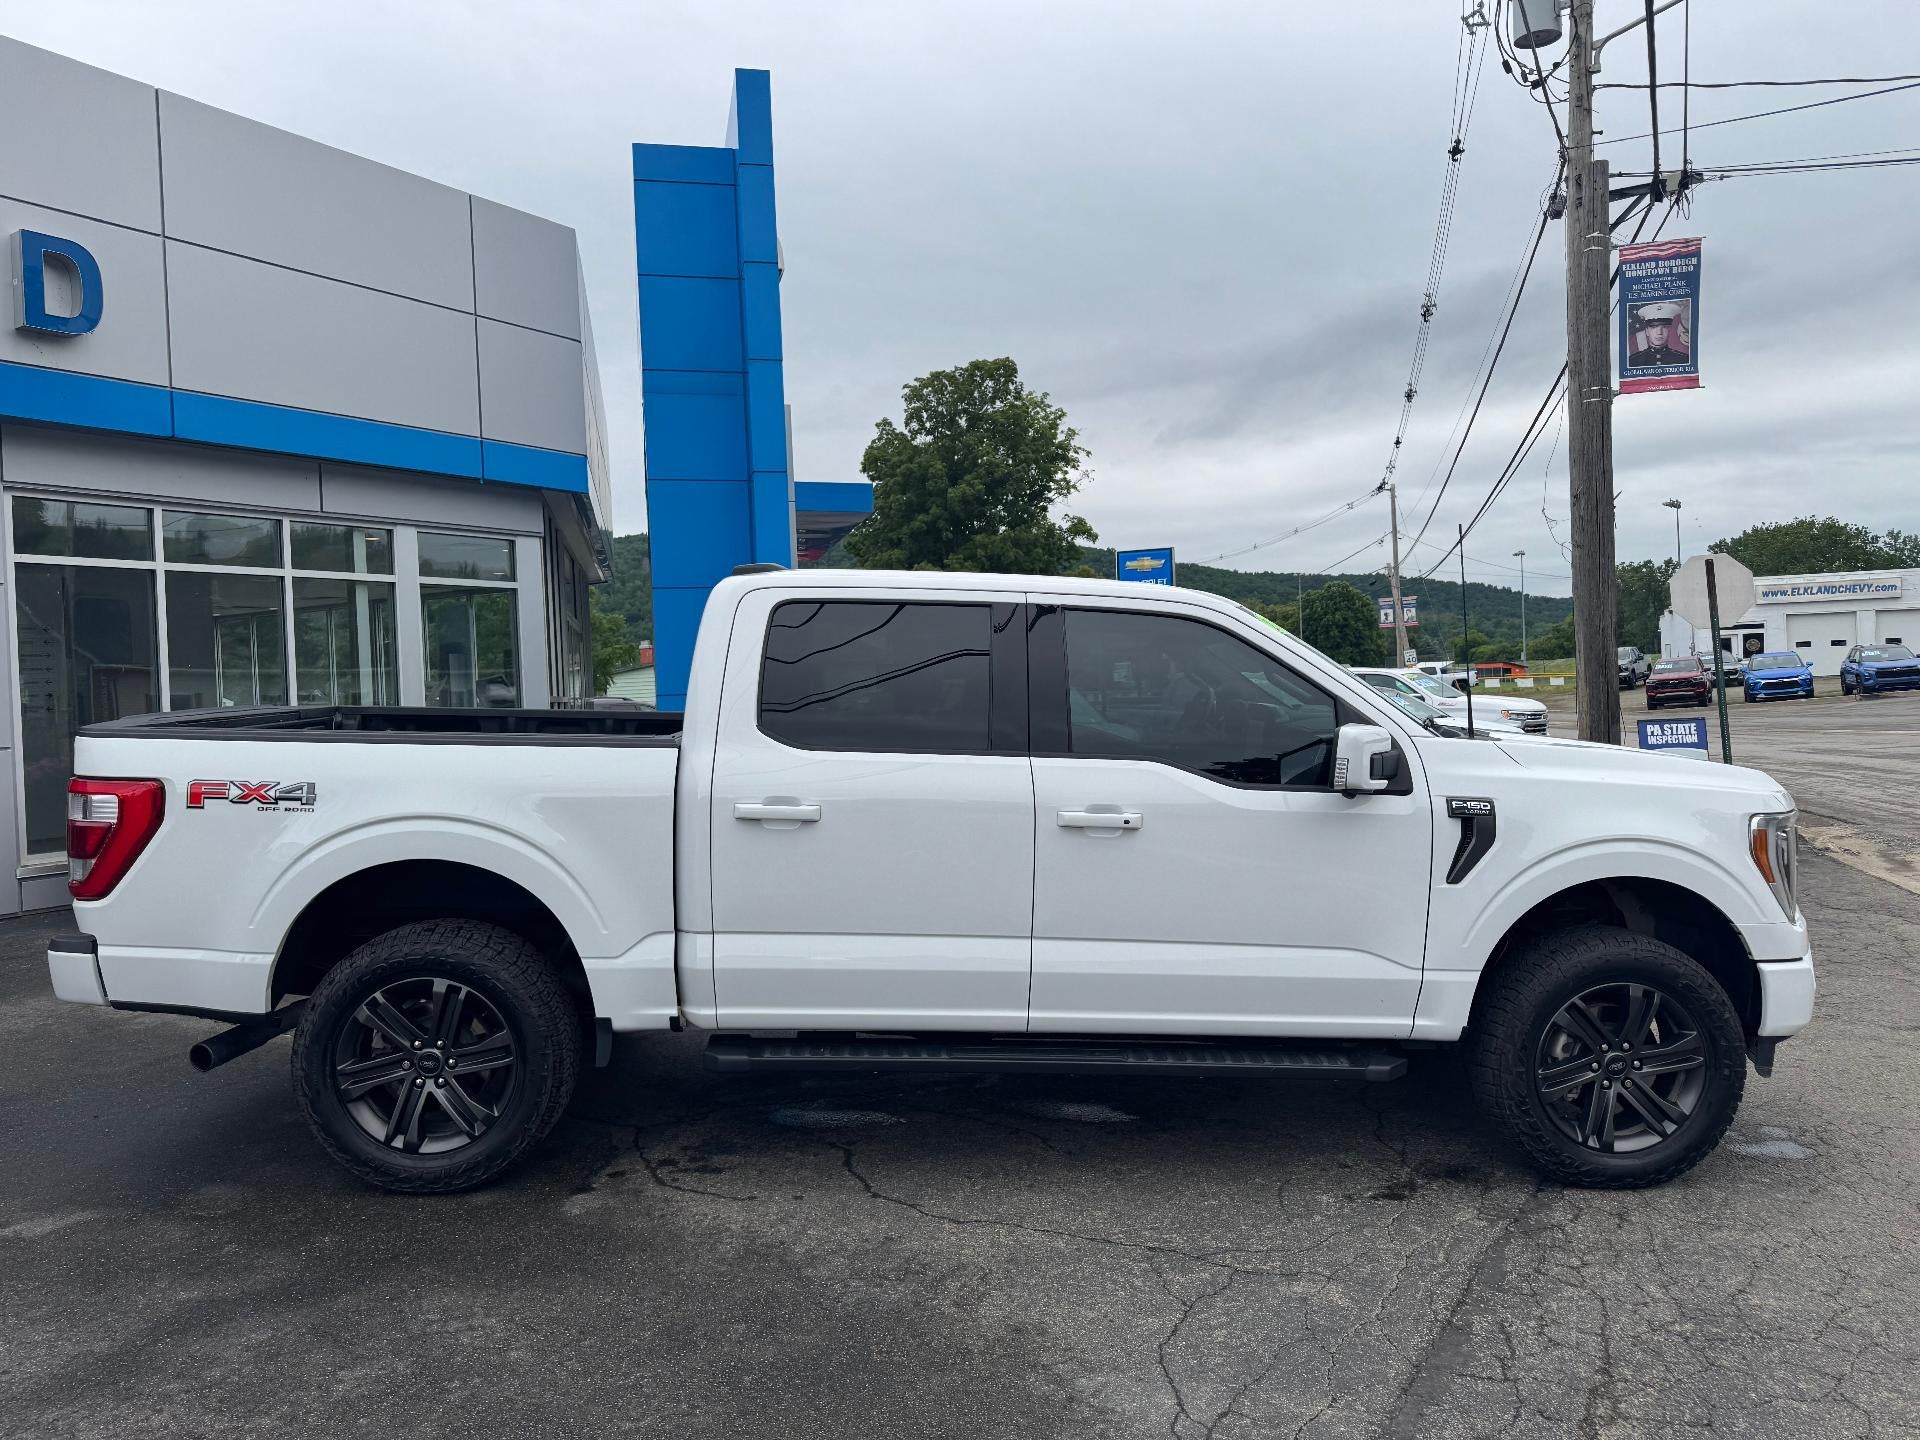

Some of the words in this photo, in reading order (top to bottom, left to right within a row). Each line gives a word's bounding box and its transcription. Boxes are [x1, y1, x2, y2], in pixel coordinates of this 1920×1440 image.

[1622, 261, 1656, 271] ELKLAND
[1658, 257, 1698, 268] BOROUGH
[1625, 267, 1670, 278] HOMETOWN
[1672, 265, 1694, 274] HERO
[12, 229, 104, 334] D
[1632, 282, 1661, 290] MICHAEL
[1664, 280, 1687, 288] PLANK
[1640, 290, 1668, 298] MARINE
[1668, 288, 1691, 296] CORPS
[1761, 583, 1898, 598] www.ELKLANDCHEVY.com
[1646, 724, 1662, 736] PA
[1663, 723, 1698, 735] STATE
[1647, 734, 1698, 745] INSPECTION
[186, 779, 317, 809] FX4
[1451, 801, 1491, 810] F-150
